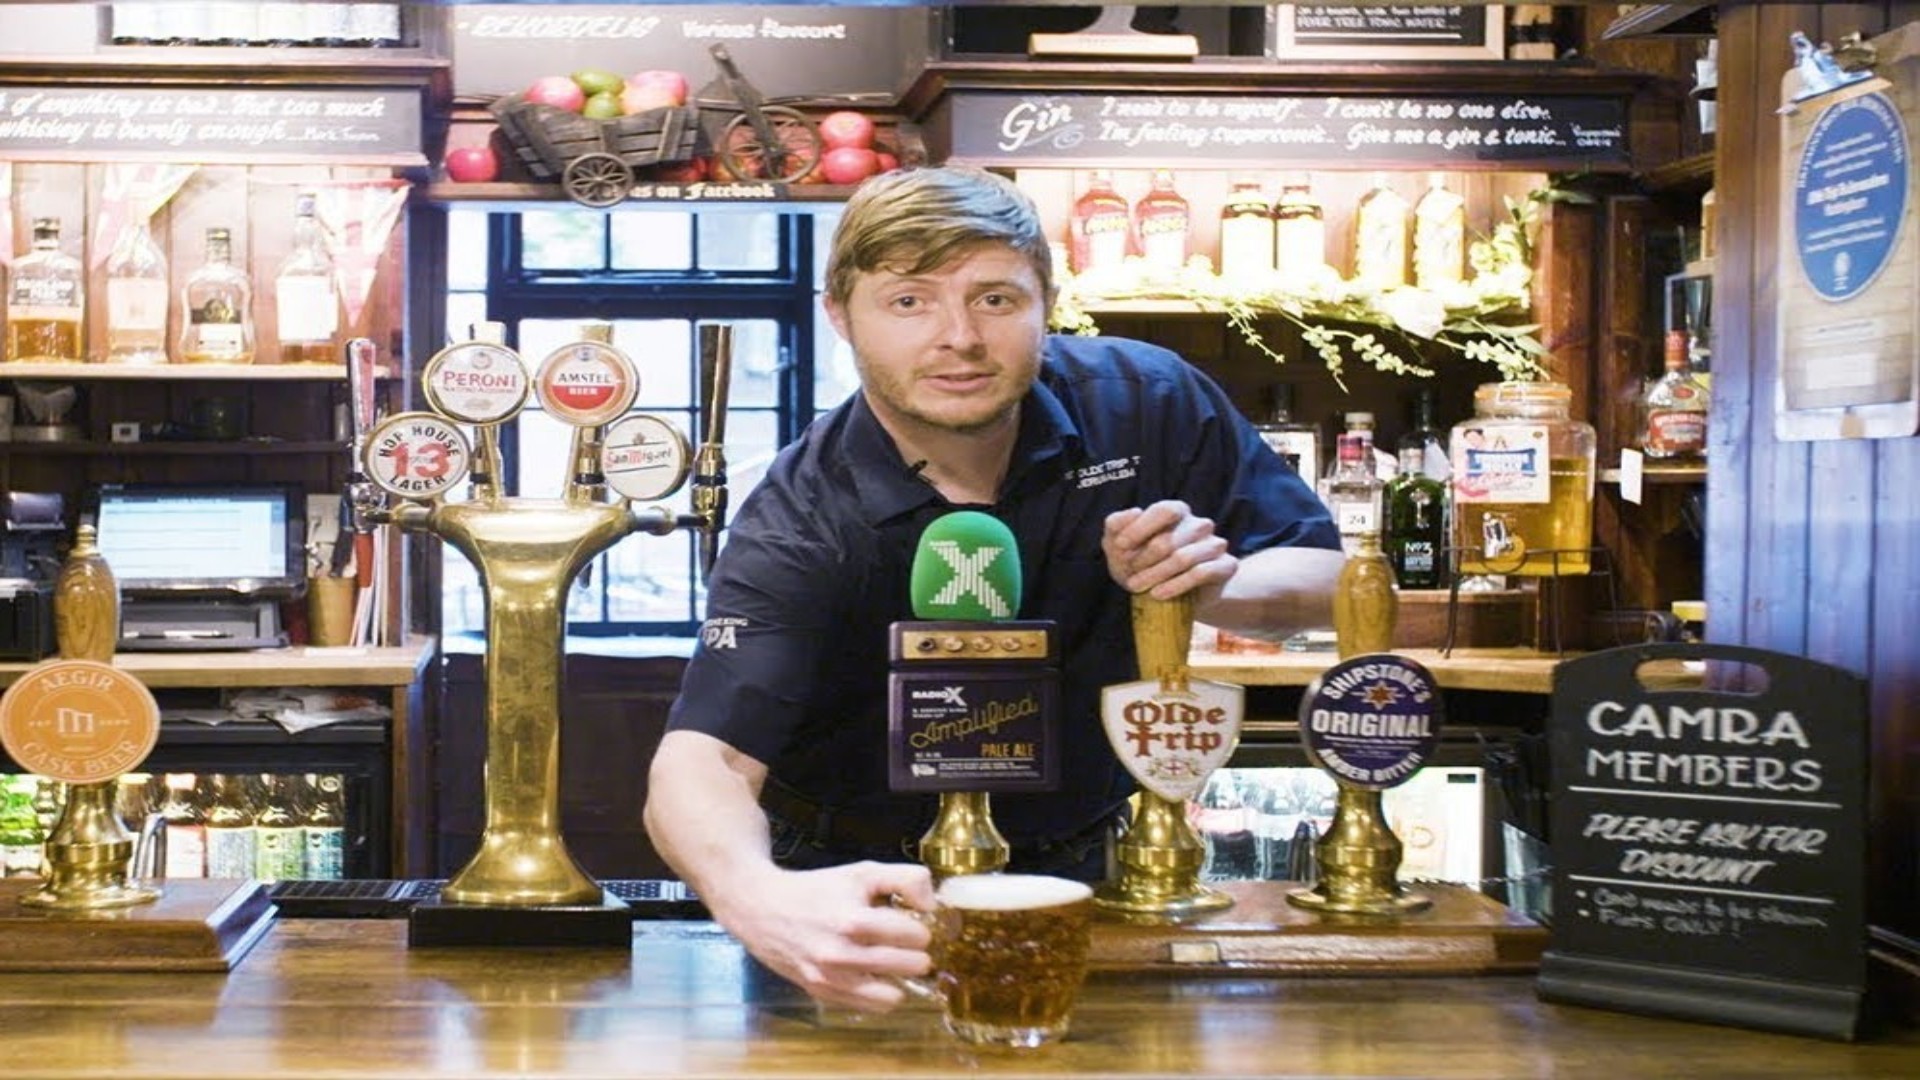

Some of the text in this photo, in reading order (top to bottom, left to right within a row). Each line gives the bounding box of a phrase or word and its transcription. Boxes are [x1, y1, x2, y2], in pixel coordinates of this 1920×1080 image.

[11, 92, 45, 117] of
[37, 92, 145, 119] anything
[148, 96, 172, 114] is
[282, 99, 320, 116] too
[324, 97, 386, 117] much
[1116, 100, 1166, 118] need
[1166, 99, 1191, 117] to
[1194, 99, 1219, 117] be
[1398, 99, 1423, 120] be
[1425, 103, 1454, 120] no
[1457, 103, 1496, 120] one
[92, 119, 116, 139] is
[117, 118, 193, 146] barely
[998, 101, 1073, 152] Gin
[1124, 121, 1208, 148] feeling
[1346, 121, 1391, 151] Give
[1393, 127, 1425, 145] me
[1426, 127, 1443, 145] a
[1442, 126, 1482, 150] gin
[656, 185, 681, 198] on
[683, 181, 776, 200] Facebook
[443, 371, 517, 388] PERONI
[558, 372, 612, 384] AMSTEL
[378, 425, 460, 458] HOP HOUSE
[390, 442, 450, 478] 13
[389, 474, 446, 492] LAGER
[928, 546, 1011, 618] X
[39, 670, 116, 692] AEGIR
[910, 691, 1039, 749] Amplified
[1123, 700, 1227, 727] Olde
[1311, 708, 1433, 738] ORIGINAL
[1586, 701, 1811, 749] CAMRA
[981, 743, 1035, 758] PALE ALE
[1126, 724, 1222, 757] Trip
[21, 740, 140, 775] CASK BEER
[1316, 748, 1371, 781] AMBER
[1372, 751, 1424, 782] BITTER
[1585, 748, 1823, 792] MEMBERS
[1582, 812, 1828, 855] PLEASE ASK FOR
[1618, 849, 1777, 884] DISCOUNT
[1728, 900, 1755, 920] be
